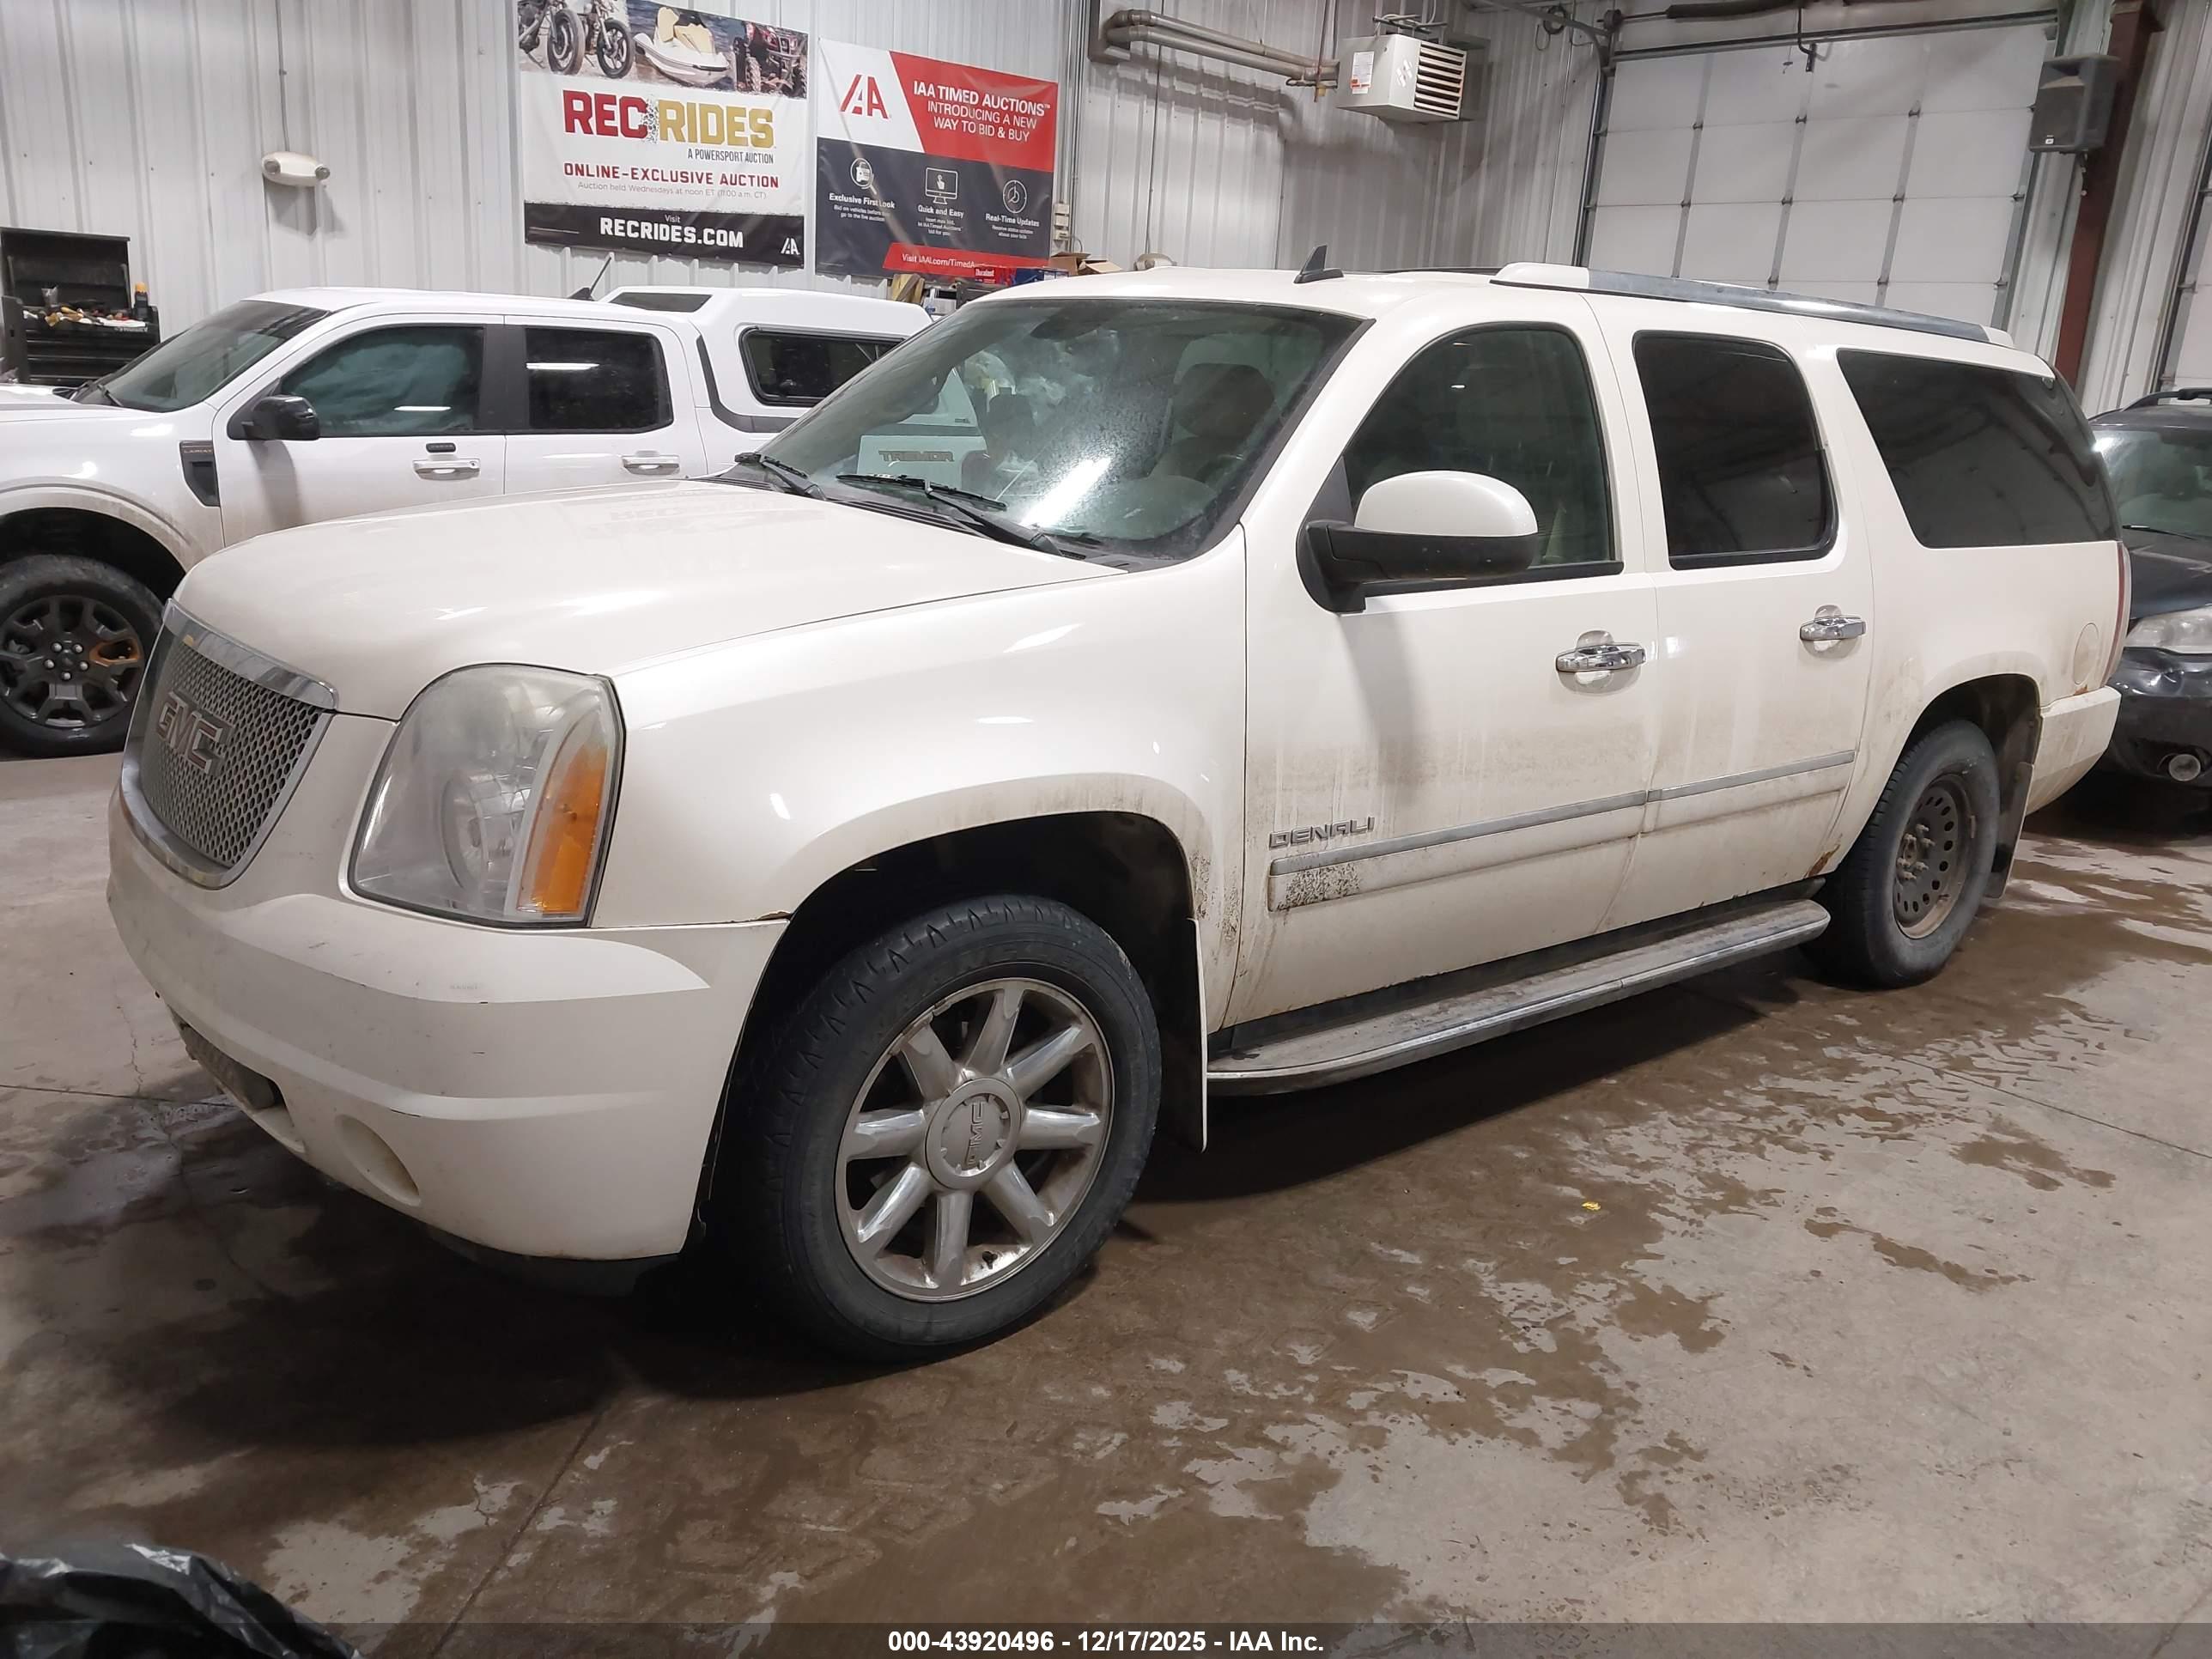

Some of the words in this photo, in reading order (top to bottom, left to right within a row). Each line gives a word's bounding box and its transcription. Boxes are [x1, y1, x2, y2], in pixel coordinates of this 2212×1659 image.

[914, 81, 935, 99] IAA
[937, 85, 979, 105] TIMED
[562, 89, 649, 139] REC
[658, 99, 775, 149] RIDES
[927, 100, 1000, 124] INTRODUCING
[1002, 115, 1011, 125] A
[1012, 116, 1037, 130] NEW
[933, 116, 959, 131] WAY
[962, 120, 976, 134] TO
[979, 123, 995, 137] BID
[997, 127, 1006, 139] &
[1008, 130, 1030, 143] BUY
[688, 148, 693, 159] A
[695, 149, 744, 162] POWERSPORT
[744, 151, 774, 164] AUCTION
[563, 162, 714, 185] ONLINE-EXCLUSIVE
[720, 173, 779, 189] AUCTION
[578, 181, 608, 190] Auction
[610, 183, 626, 191] held
[629, 184, 674, 194] Wednesdays
[829, 192, 862, 204] Exclusive
[863, 197, 878, 206] First
[879, 200, 896, 209] Look
[918, 204, 934, 214] Quick
[949, 209, 964, 219] Easy
[665, 214, 681, 222] Visit
[985, 213, 1016, 224] Real-Time
[1017, 216, 1040, 227] Updates
[600, 217, 744, 248] RECRIDES.COM
[902, 253, 917, 263] Visit
[878, 449, 955, 462] TREMOR
[158, 690, 225, 775] GMC
[1268, 816, 1376, 849] DENALI
[965, 1100, 988, 1168] GMC
